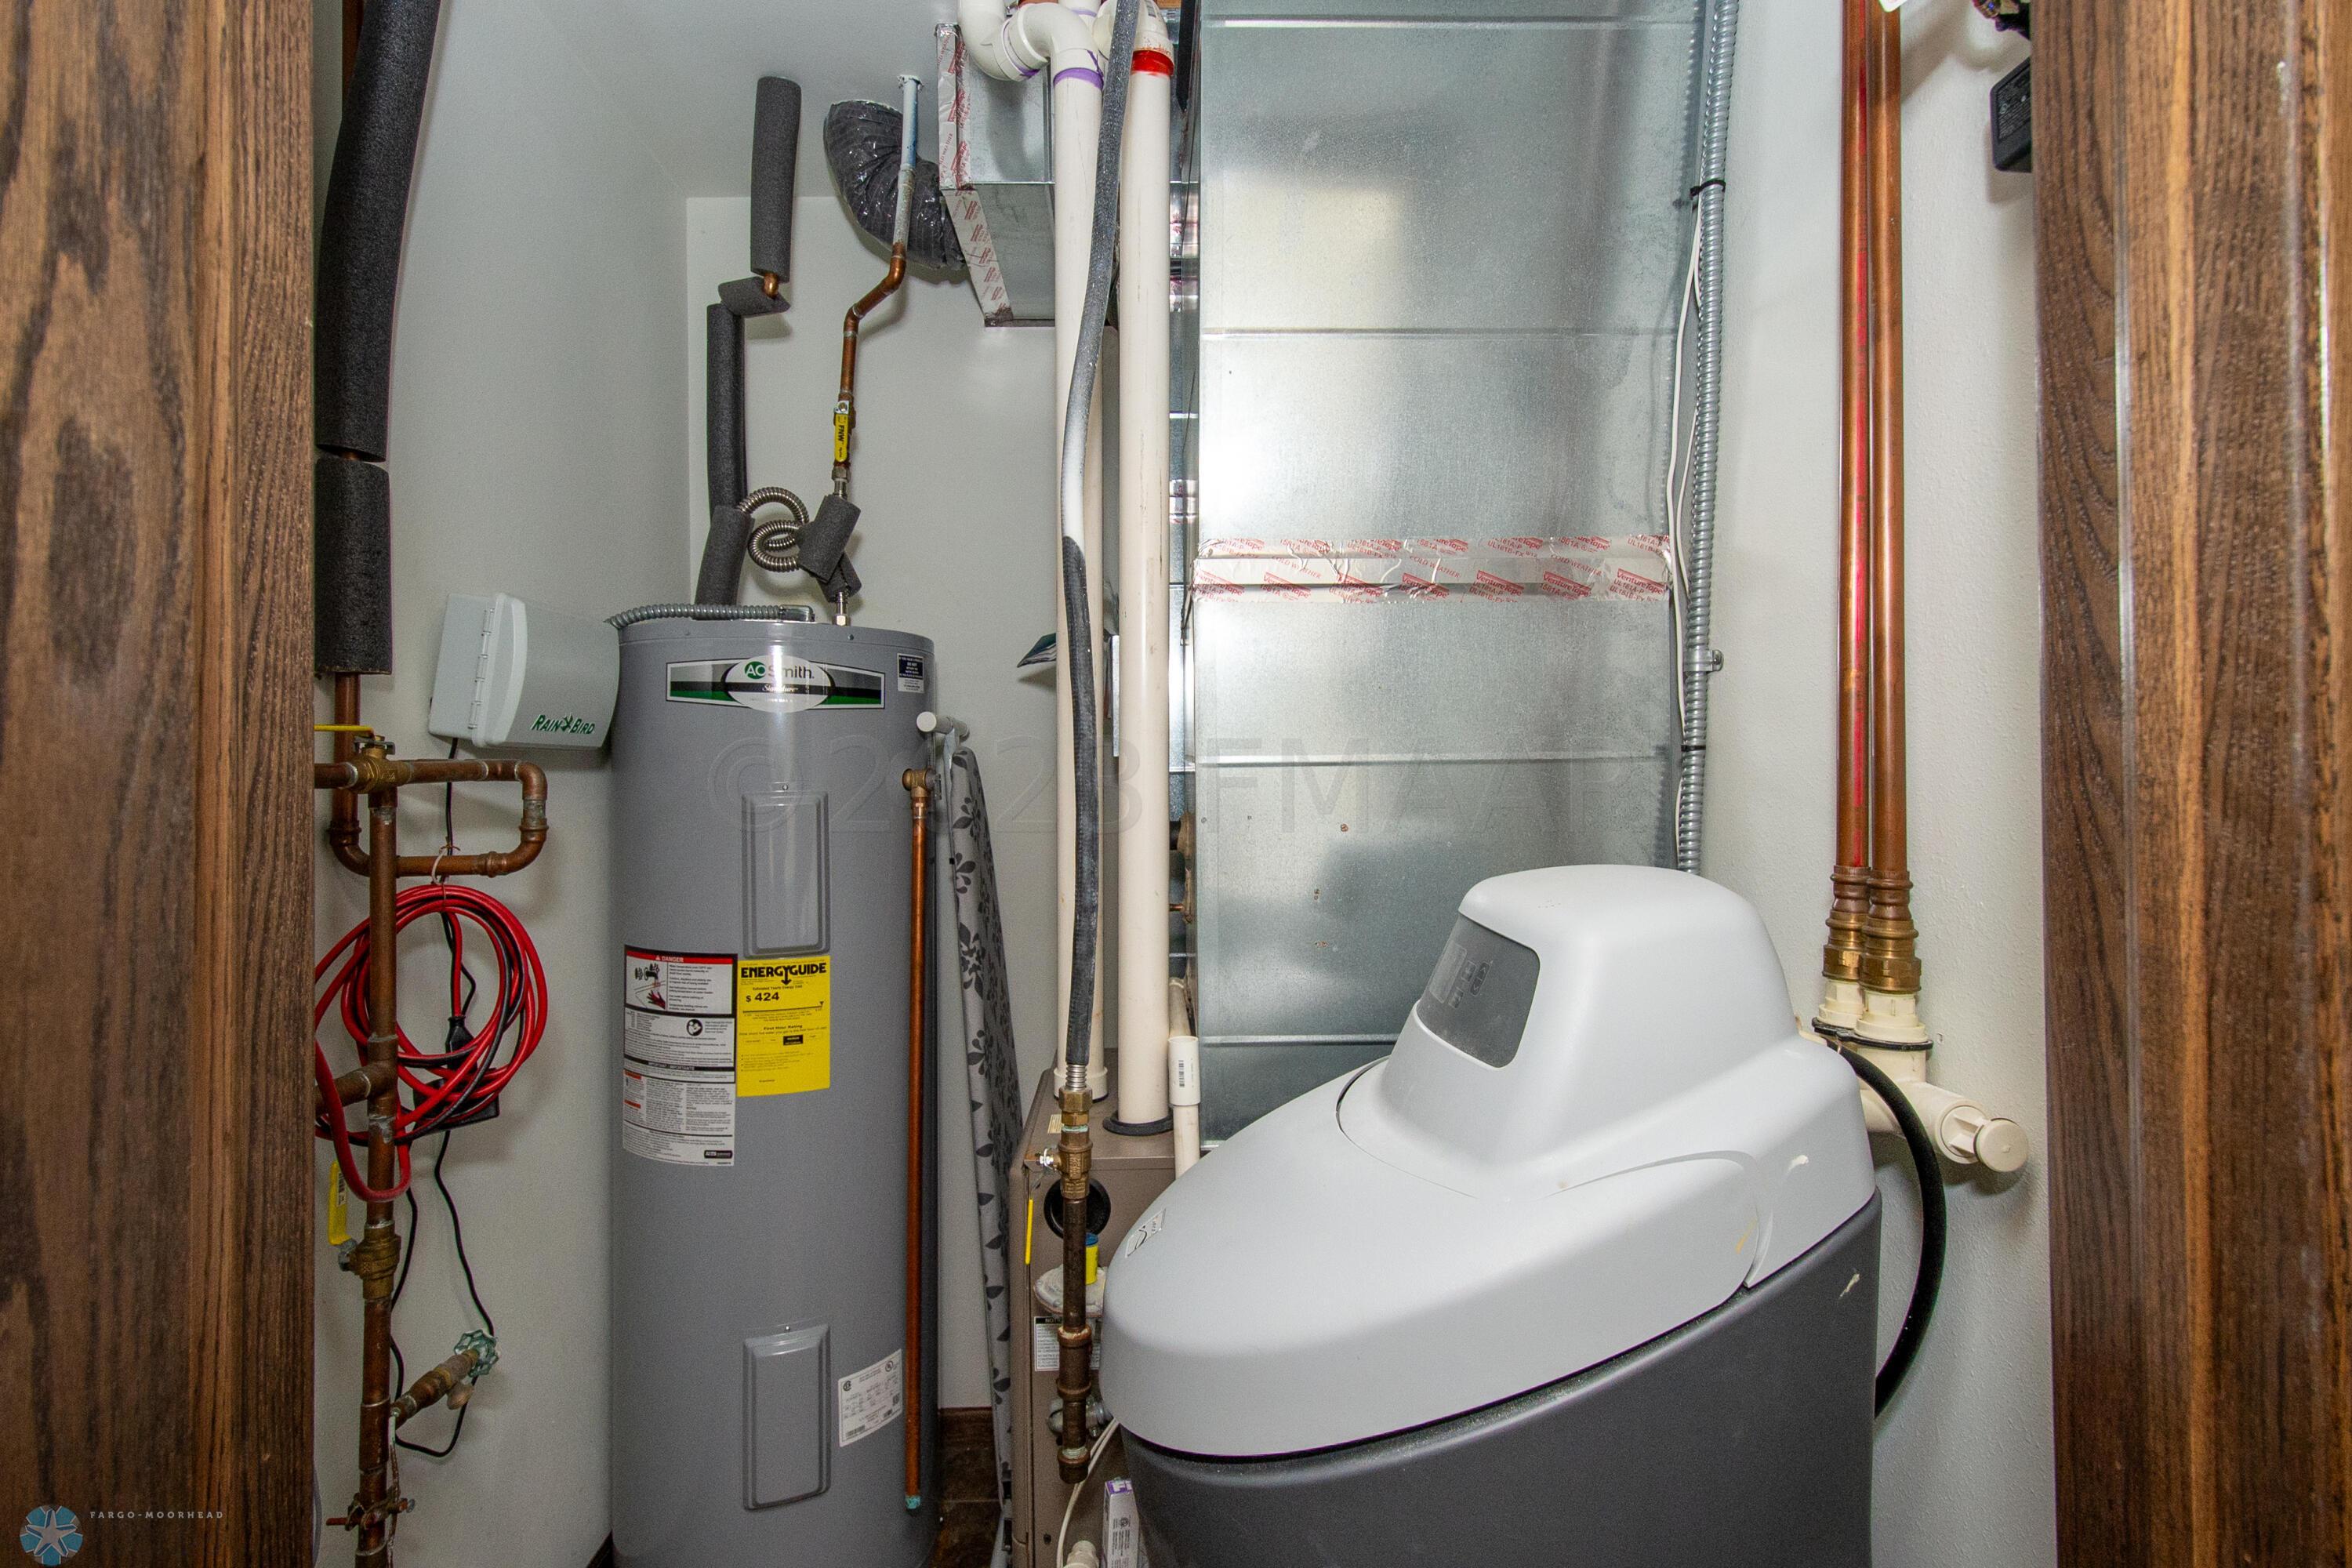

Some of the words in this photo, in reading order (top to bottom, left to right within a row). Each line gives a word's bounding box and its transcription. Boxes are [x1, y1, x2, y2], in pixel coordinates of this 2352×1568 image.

[1617, 572, 1664, 595] VentureTape
[531, 714, 562, 732] RAIN
[568, 718, 596, 735] BIRD
[741, 963, 826, 982] ENERGYGUIDE
[755, 992, 780, 1002] 424
